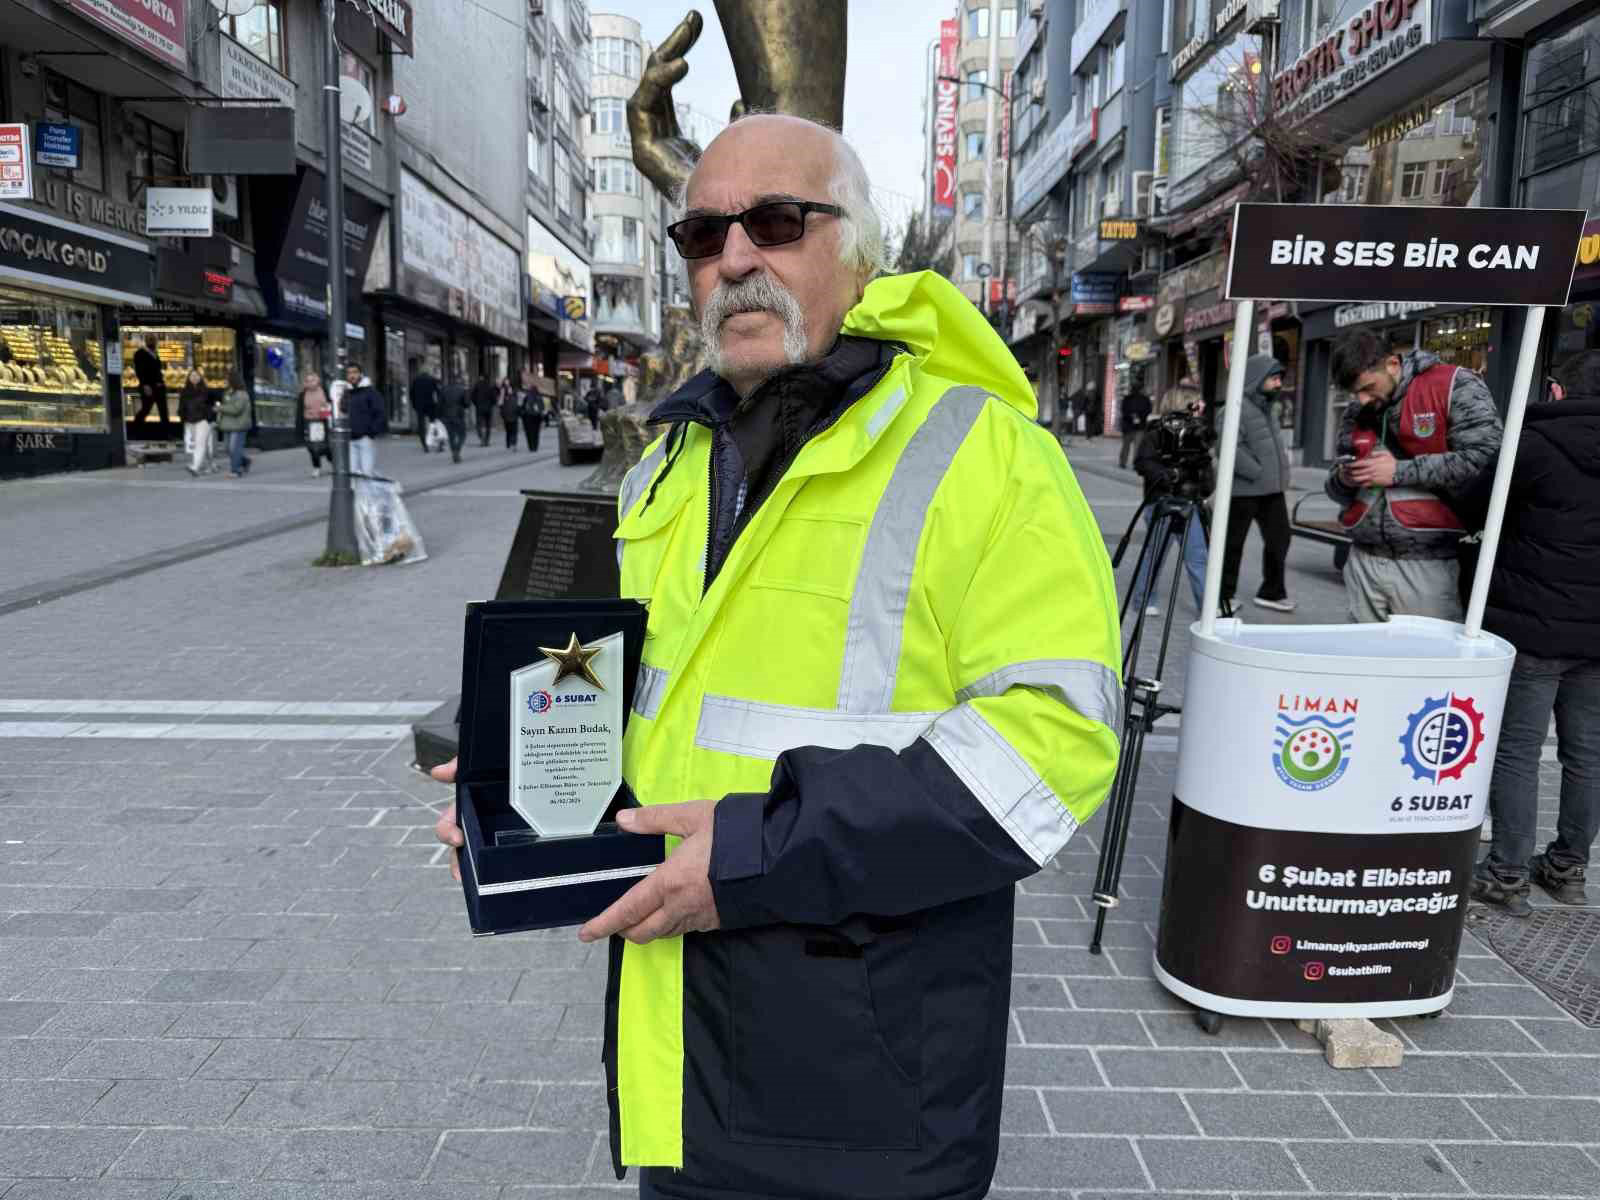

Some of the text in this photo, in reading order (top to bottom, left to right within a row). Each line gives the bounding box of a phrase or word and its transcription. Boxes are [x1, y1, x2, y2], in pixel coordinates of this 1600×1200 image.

[61, 243, 107, 273] GOLD
[1270, 233, 1326, 266] BİR
[1332, 240, 1395, 268] SES
[1403, 237, 1459, 269] BİR
[1467, 244, 1540, 270] CAN
[16, 433, 56, 453] ŞARK
[1390, 794, 1473, 812] 6 SUBAT
[1259, 864, 1452, 888] 6 Şubat Elbistan
[1246, 889, 1459, 917] Unutturmayacağız
